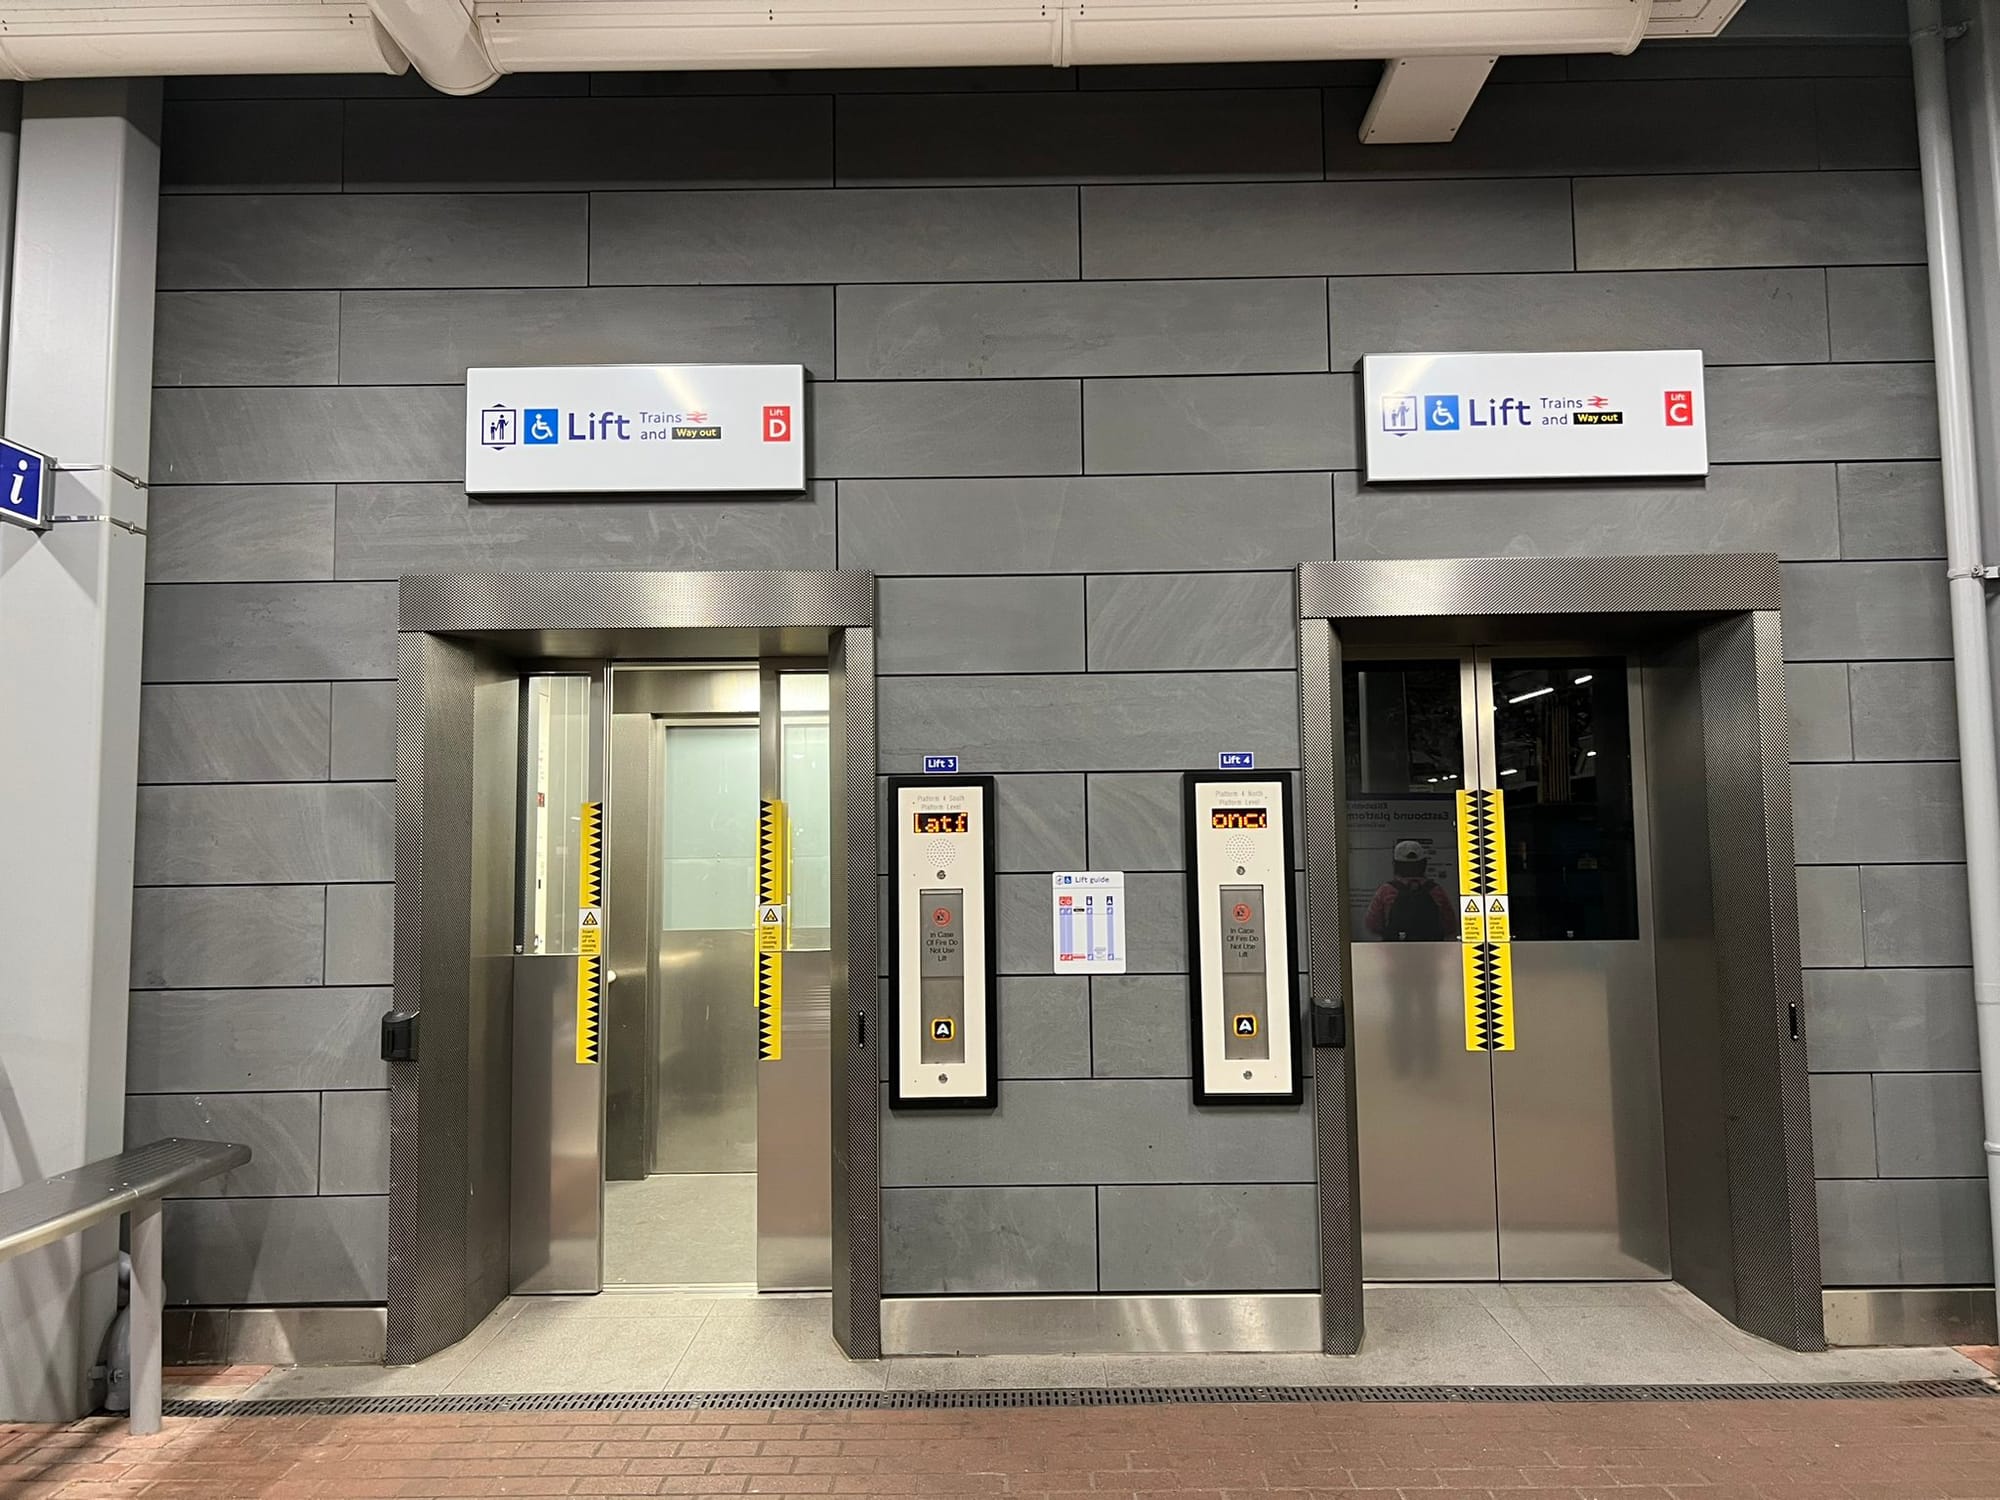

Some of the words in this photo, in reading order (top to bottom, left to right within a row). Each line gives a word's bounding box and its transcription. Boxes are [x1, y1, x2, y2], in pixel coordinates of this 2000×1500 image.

[1540, 397, 1583, 410] Trains
[1671, 393, 1685, 401] Lift
[640, 411, 682, 424] Trains
[769, 409, 784, 417] Lift
[1469, 398, 1531, 427] Lift
[1542, 413, 1568, 426] and
[1577, 412, 1599, 424] Way
[1600, 413, 1618, 423] out
[1670, 404, 1689, 423] C
[568, 411, 631, 441] Lift
[768, 419, 787, 437] D
[640, 427, 666, 440] and
[676, 428, 698, 439] Way
[699, 428, 717, 438] out
[928, 759, 946, 768] Lift
[948, 759, 954, 768] 3
[1223, 756, 1240, 764] Lift
[1243, 756, 1250, 764] 4
[1090, 876, 1110, 884] guide
